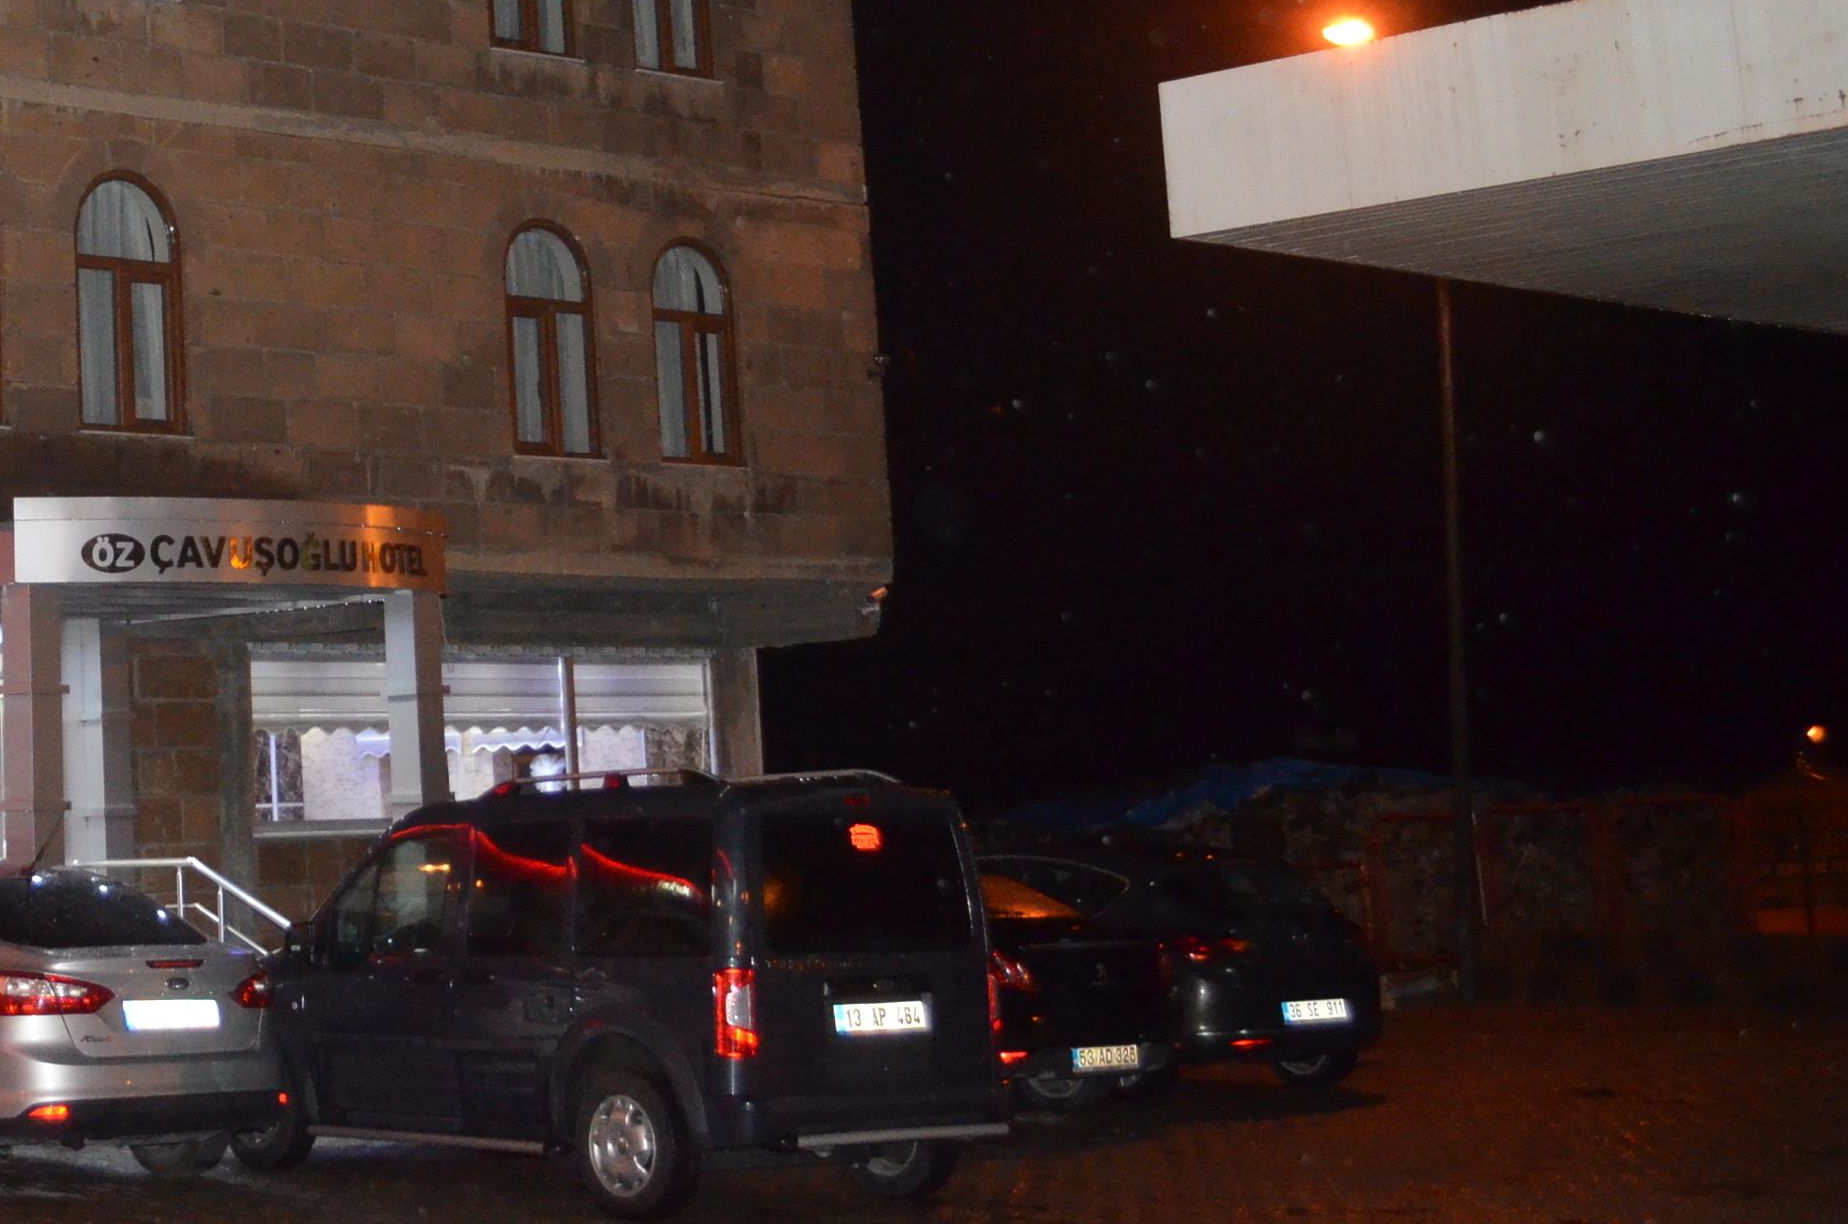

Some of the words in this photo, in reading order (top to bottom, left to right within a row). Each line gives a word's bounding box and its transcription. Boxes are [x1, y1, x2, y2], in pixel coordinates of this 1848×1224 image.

[92, 536, 136, 568] ÖZ
[150, 532, 357, 576] ÇAVUŞOĞLU
[361, 540, 428, 578] HOTEL
[846, 1008, 862, 1028] 13
[872, 1006, 887, 1027] AP
[897, 1005, 921, 1025] 464
[1289, 1003, 1302, 1018] 36
[1307, 1002, 1320, 1017] SE
[1326, 1000, 1344, 1016] 911
[1079, 1049, 1094, 1066] 53
[1099, 1047, 1113, 1065] AD
[1115, 1046, 1137, 1064] 325
